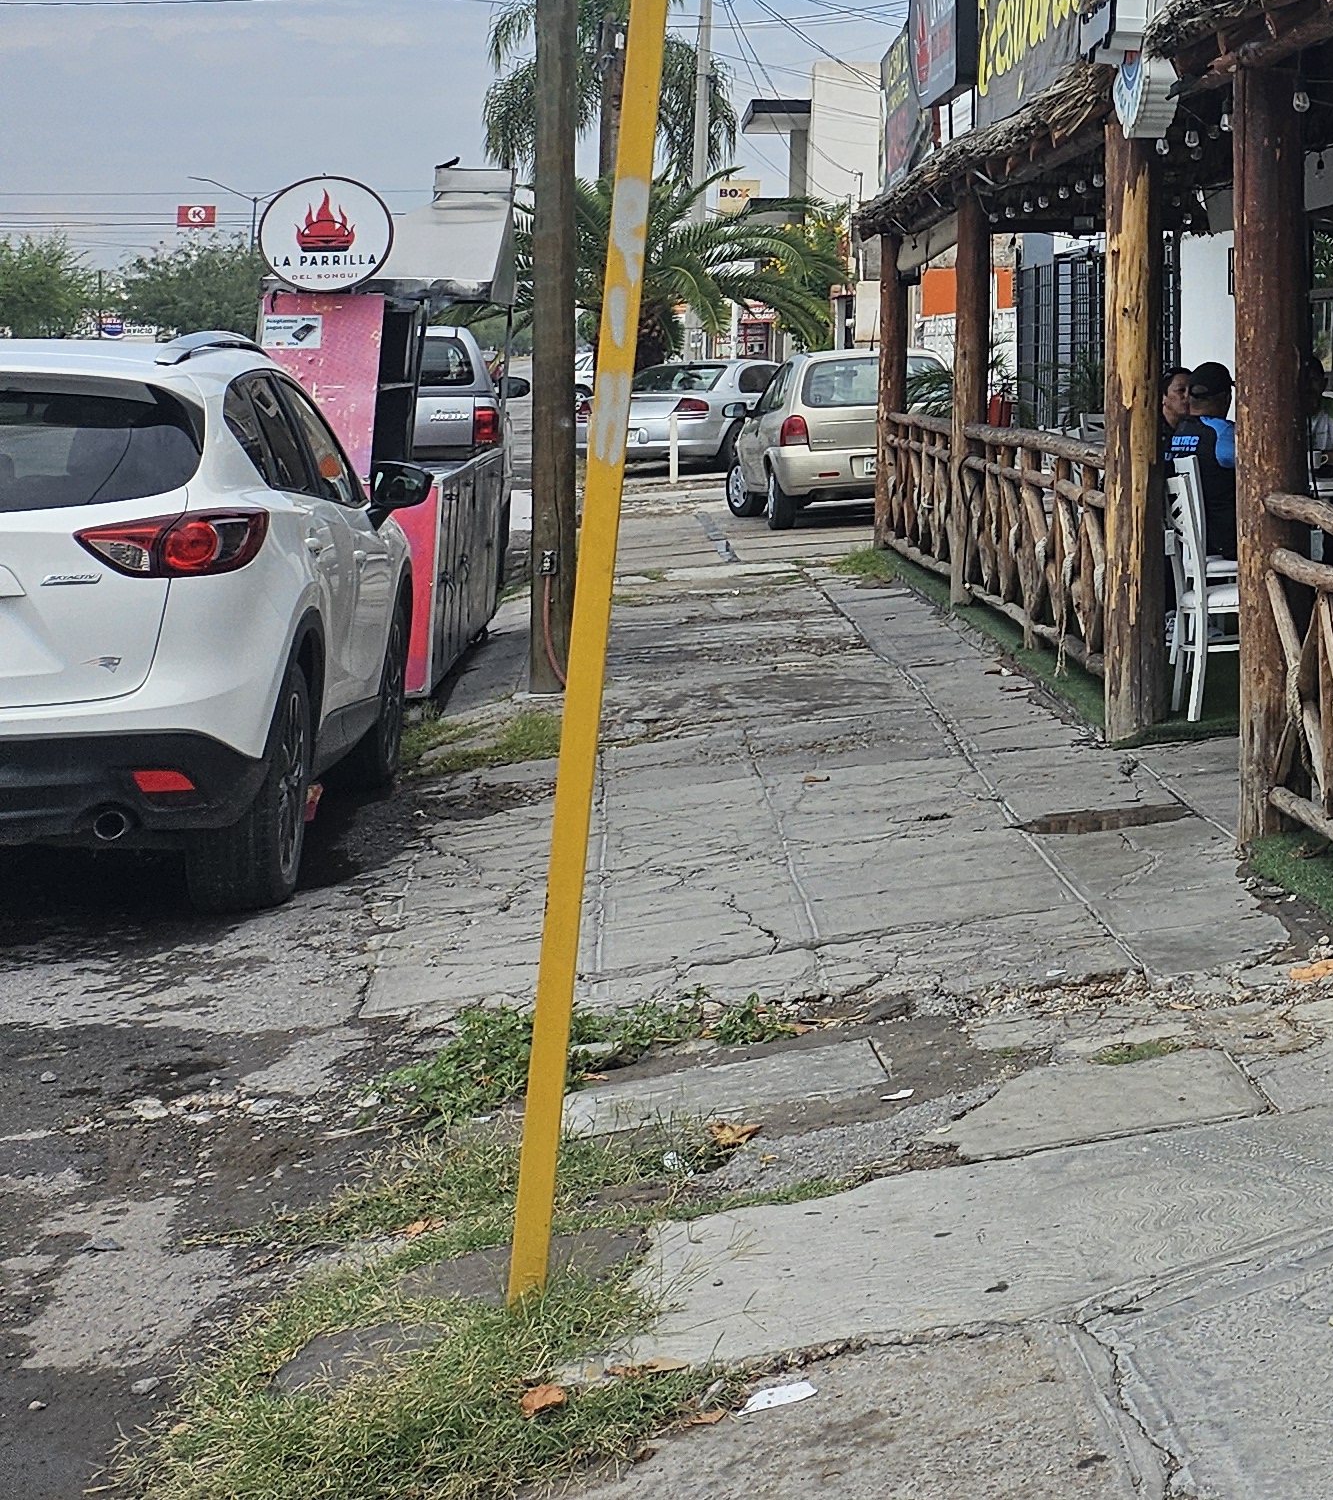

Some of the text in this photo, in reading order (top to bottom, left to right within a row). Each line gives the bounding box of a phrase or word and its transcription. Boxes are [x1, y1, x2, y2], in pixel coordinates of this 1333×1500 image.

[719, 188, 751, 199] BOX
[192, 209, 204, 221] K
[273, 253, 377, 267] LA PARRILLA
